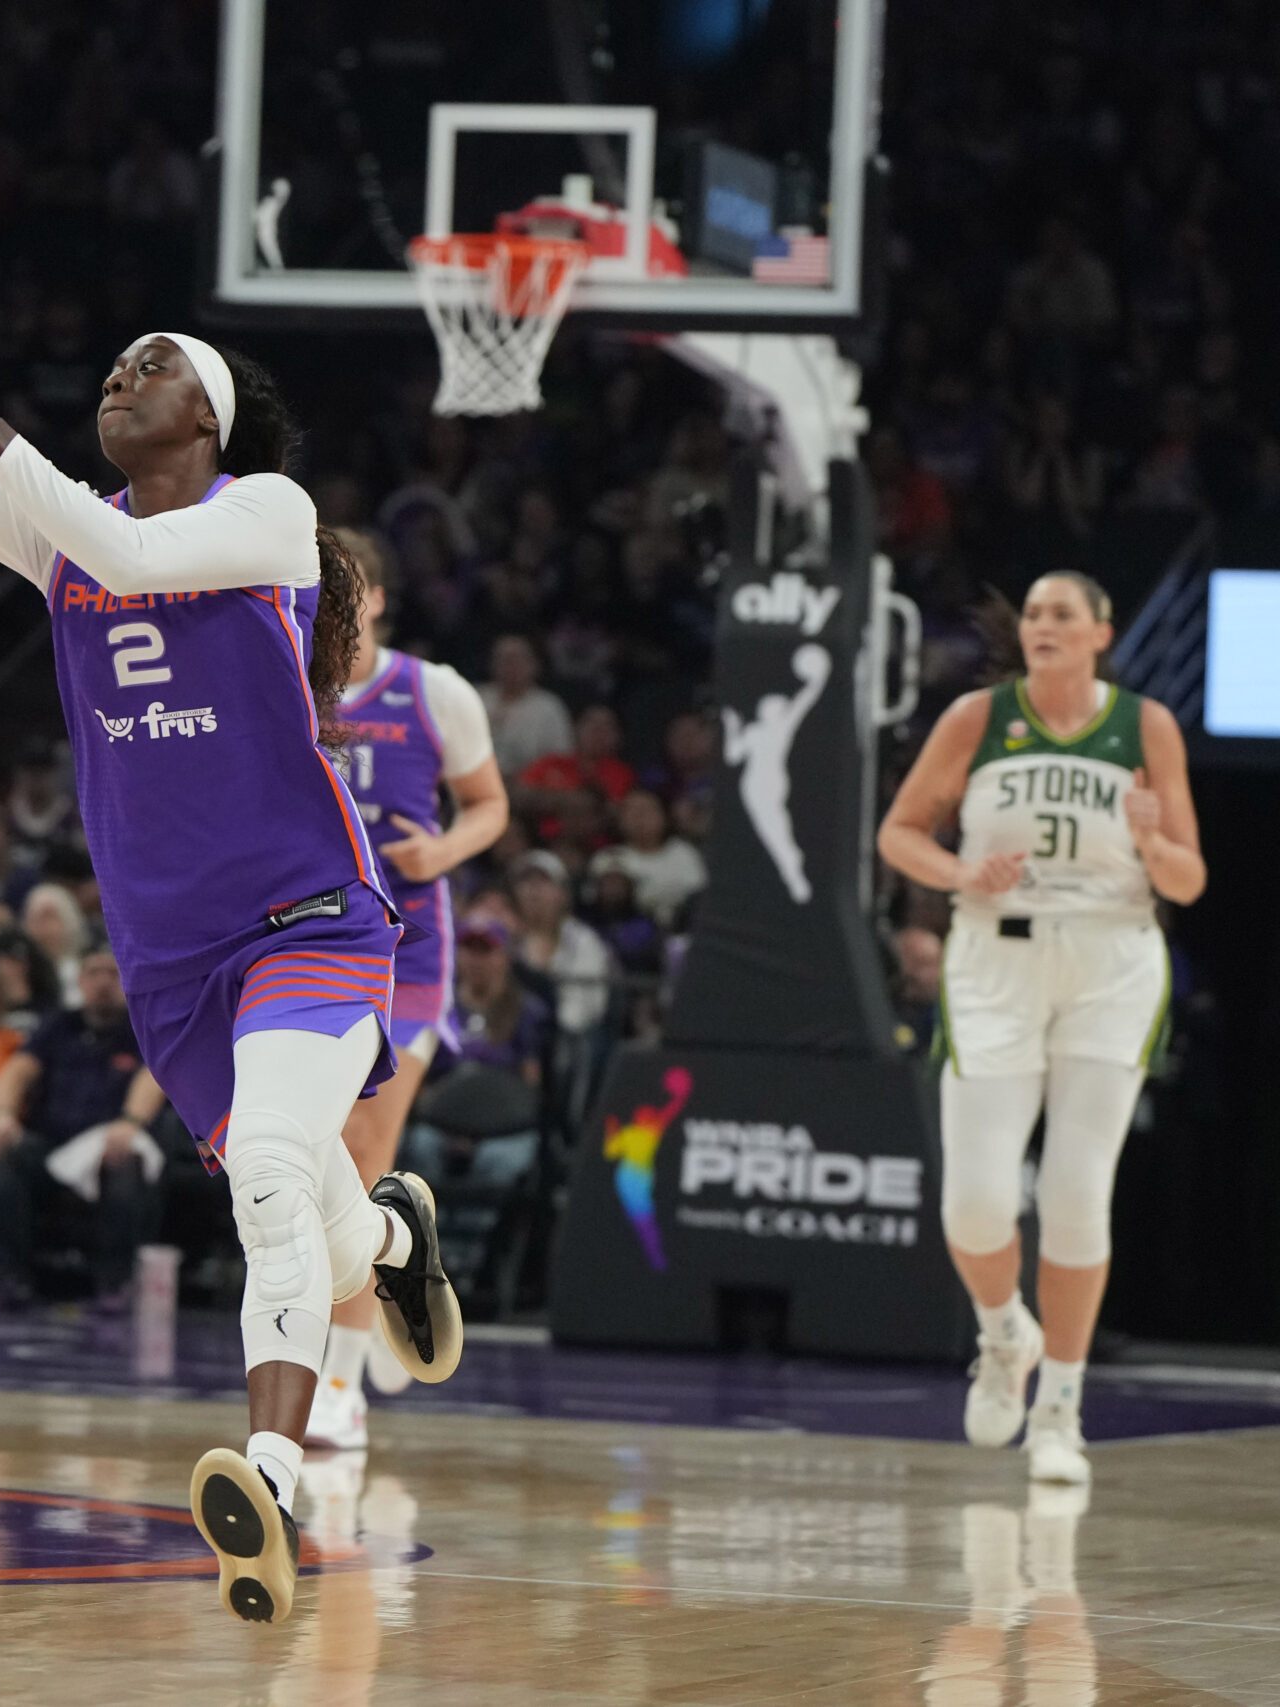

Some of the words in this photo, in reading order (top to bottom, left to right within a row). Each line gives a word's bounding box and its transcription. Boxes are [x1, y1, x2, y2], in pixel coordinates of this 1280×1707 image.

[732, 572, 841, 637] ally
[107, 622, 173, 689] 2
[140, 701, 218, 740] fry's
[995, 763, 1118, 820] STORM
[1033, 812, 1079, 860] 31
[681, 1147, 922, 1208] PRIDE
[743, 1207, 917, 1246] COACH
